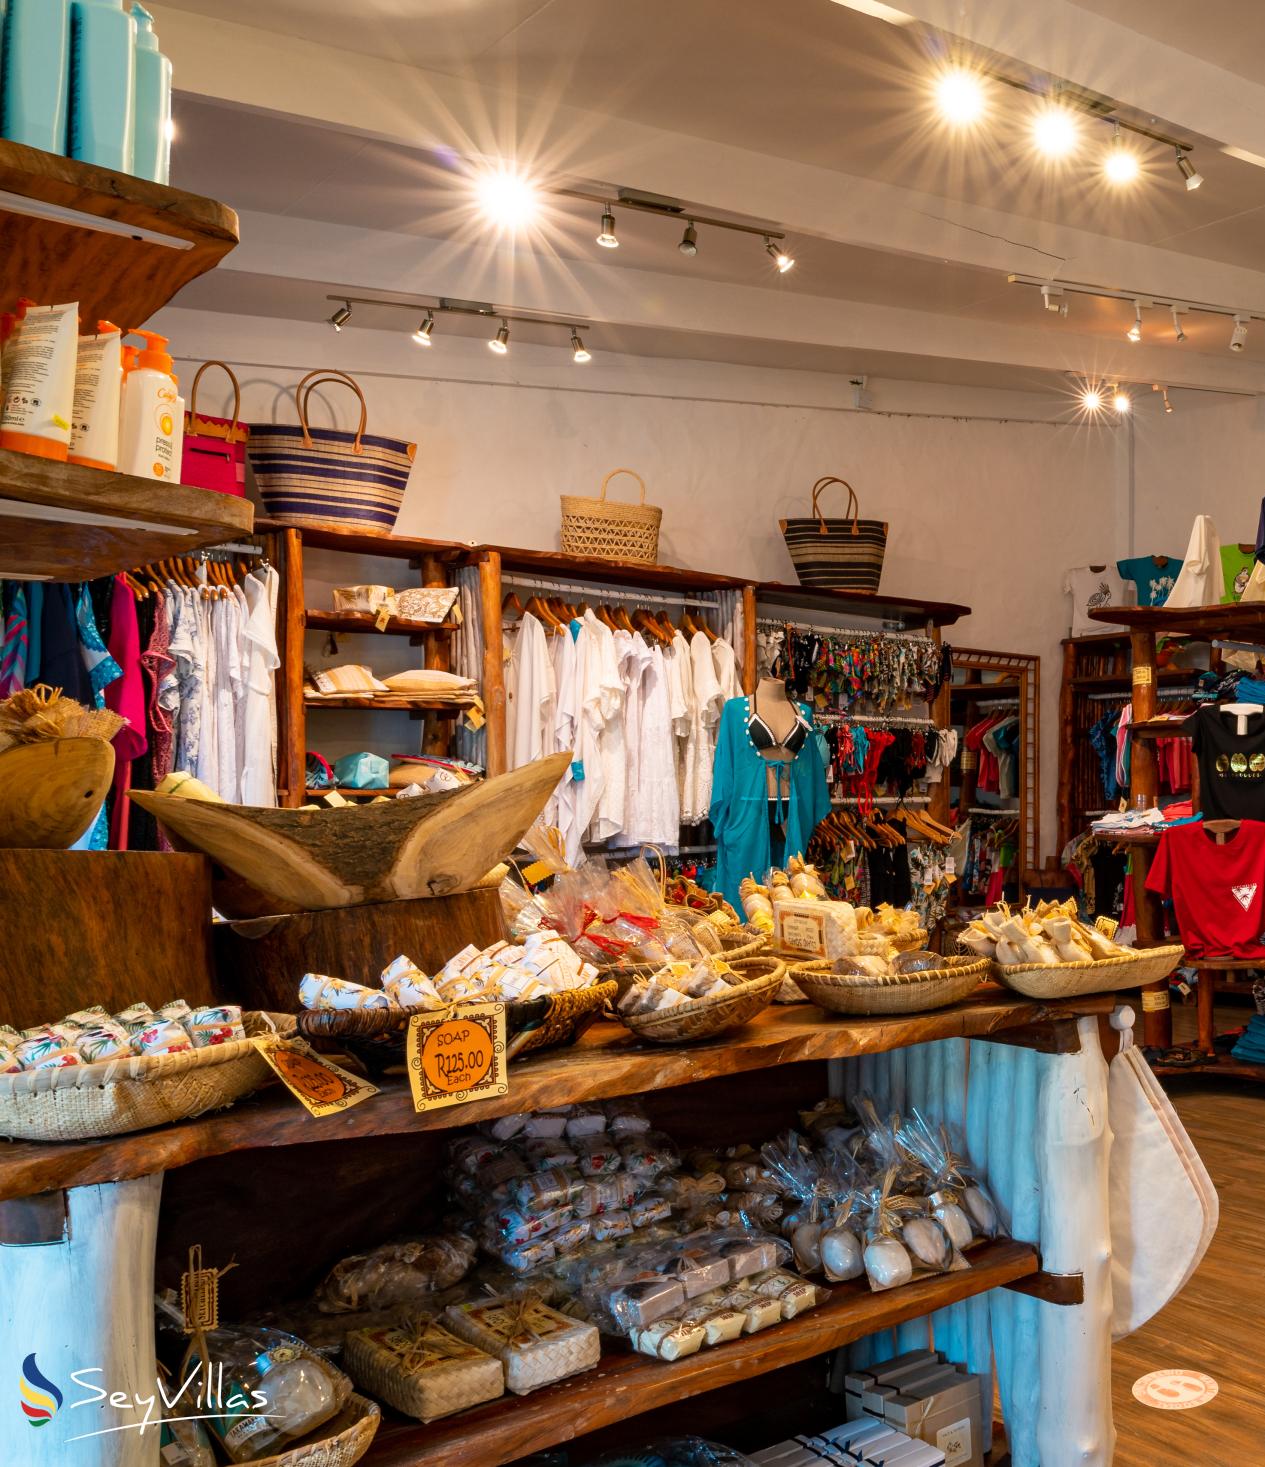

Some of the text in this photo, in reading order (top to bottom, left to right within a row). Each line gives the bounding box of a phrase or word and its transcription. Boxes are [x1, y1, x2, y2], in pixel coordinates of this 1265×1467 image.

[437, 1029, 470, 1047] SOAP
[434, 1049, 484, 1078] R125.00
[447, 1072, 472, 1086] Each
